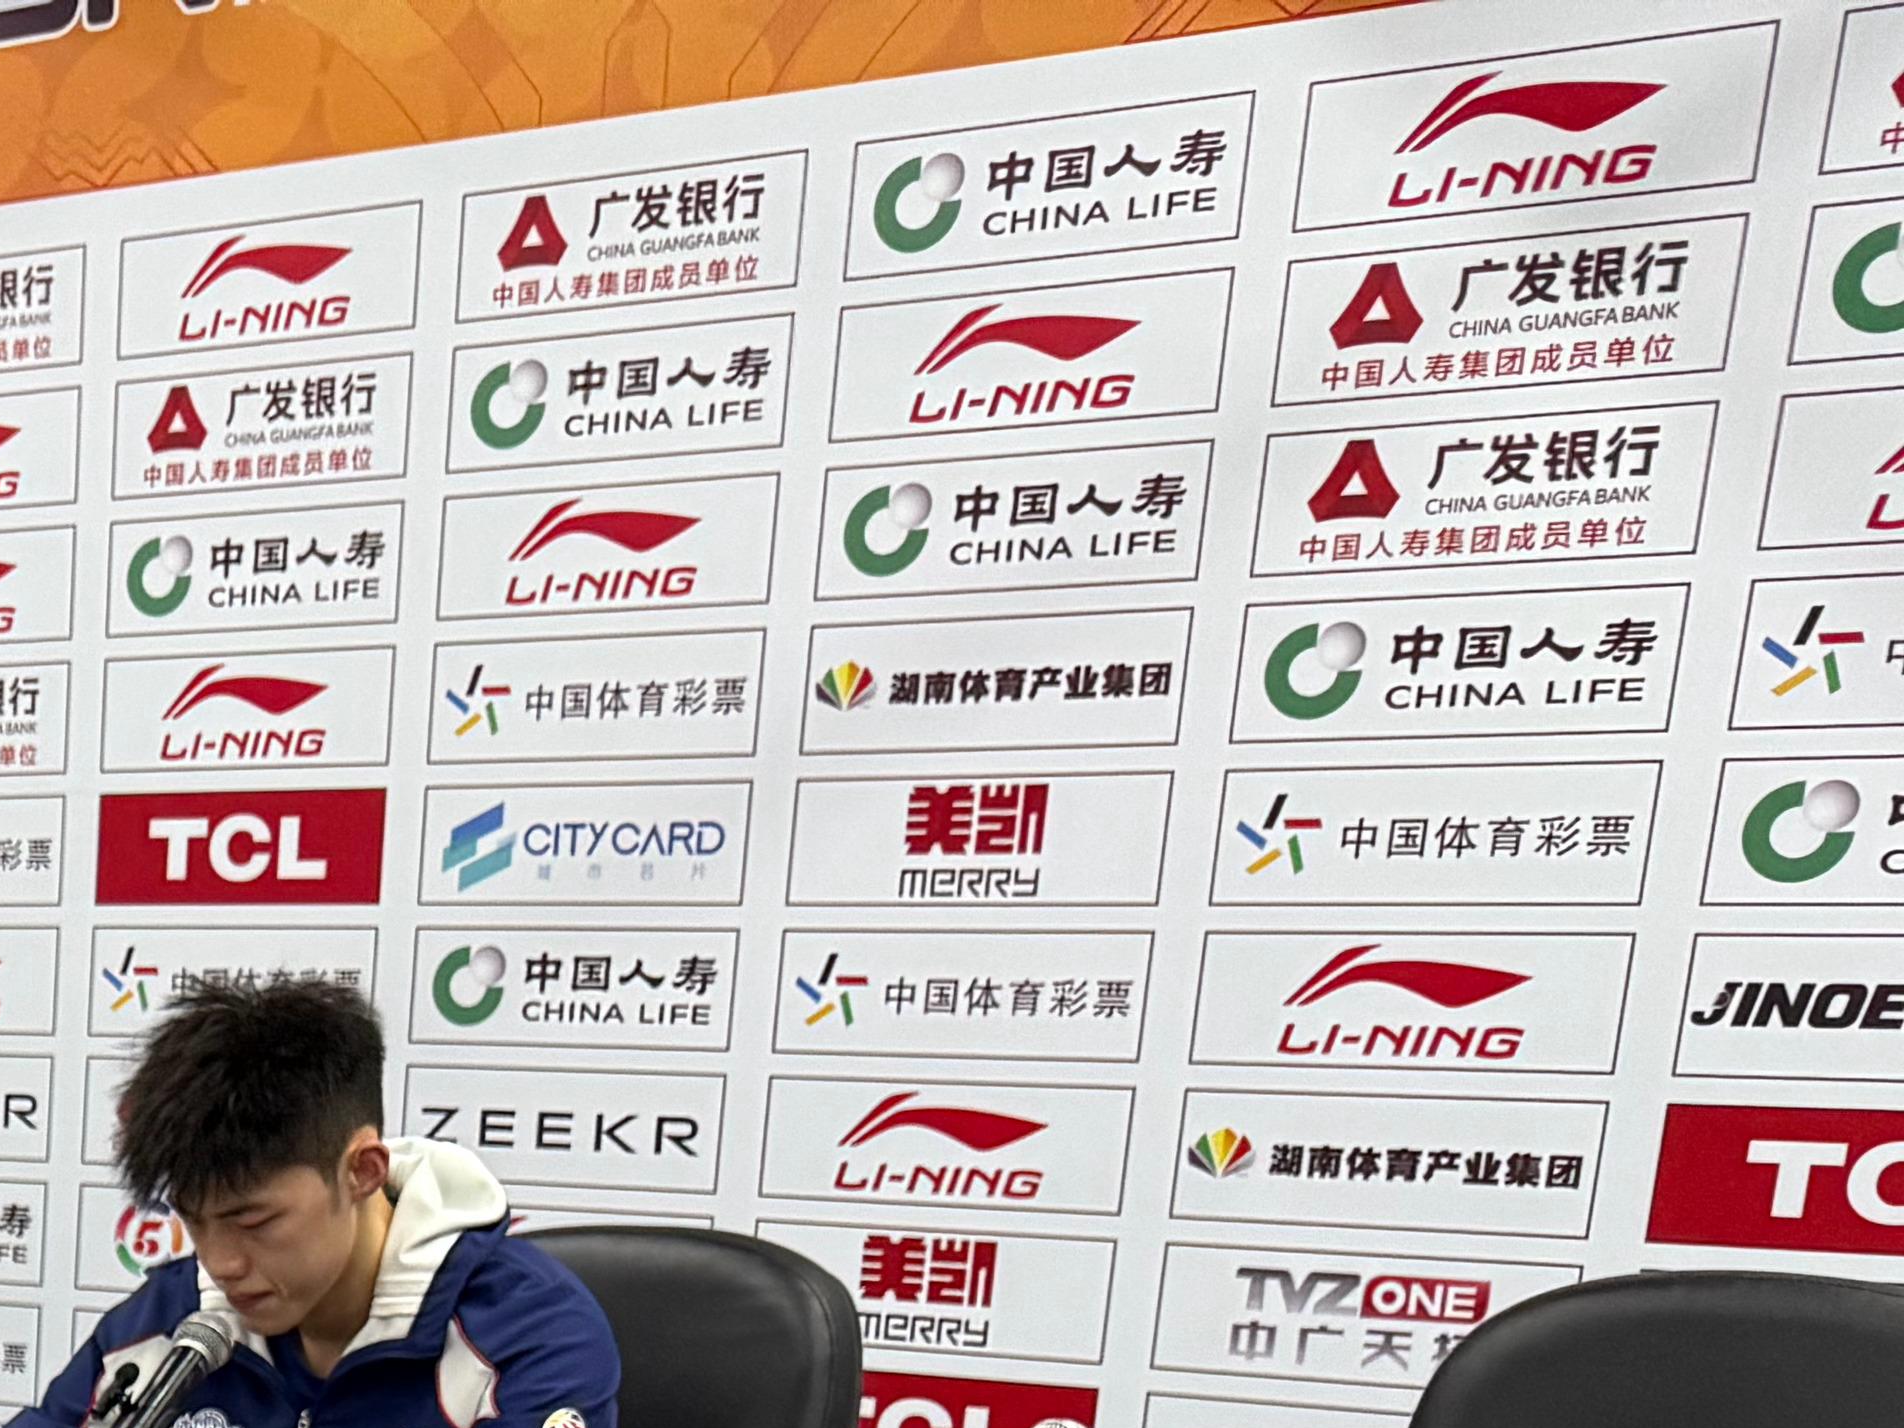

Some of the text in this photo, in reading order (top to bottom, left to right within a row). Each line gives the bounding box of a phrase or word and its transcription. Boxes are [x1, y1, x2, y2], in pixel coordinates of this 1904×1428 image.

[988, 129, 1227, 201] 中国人寿
[1388, 145, 1657, 207] LI-NING
[589, 174, 764, 245] 广发银行
[983, 187, 1217, 235] CHINA LIFE
[587, 242, 635, 262] CHINA
[493, 256, 758, 308] 中国人寿集团成员单位
[1451, 240, 1688, 312] 广发银行
[179, 296, 350, 341] LI-NING
[1449, 301, 1680, 338] CHINA GUANGFA BANK
[568, 346, 771, 405] 中国人寿
[1322, 334, 1674, 391] 中国人寿集团成员单位
[226, 373, 376, 426] 广发银行
[565, 399, 763, 437] CHINA LIFE
[910, 375, 1135, 423] LI-NING
[144, 447, 371, 487] 中国人寿集团成员单位
[1428, 425, 1660, 489] 广发银行
[954, 474, 1187, 532] 中国人寿
[1425, 485, 1651, 515] CHINA GUANGFA BANK
[211, 530, 385, 579] 中国人寿
[950, 529, 1176, 565] CHINA LIFE
[1300, 516, 1646, 563] 中国人寿集团成员单位
[208, 578, 379, 607] CHINA LIFE
[506, 567, 697, 605] LI-NING
[1391, 618, 1658, 675] 中国人寿
[526, 677, 746, 721] 中国体育彩票
[889, 662, 1172, 704] 湖南体育产业集团
[1385, 678, 1645, 709] CHINA LIFE
[161, 729, 326, 760] LI-NING
[905, 784, 1049, 854] 美凯
[1341, 816, 1634, 859] 中国体育彩票
[149, 814, 327, 882] TCL
[525, 952, 717, 995] 中国人寿
[522, 1001, 710, 1025] CHINA LIFE
[885, 977, 1133, 1018] 中国体育彩票
[1278, 1024, 1524, 1059] LI-NING
[423, 1108, 700, 1157] ZEEKR
[835, 1162, 1043, 1199] LI-NING
[1269, 1144, 1583, 1189] 湖南体育产业集团
[860, 1235, 997, 1307] 美凯
